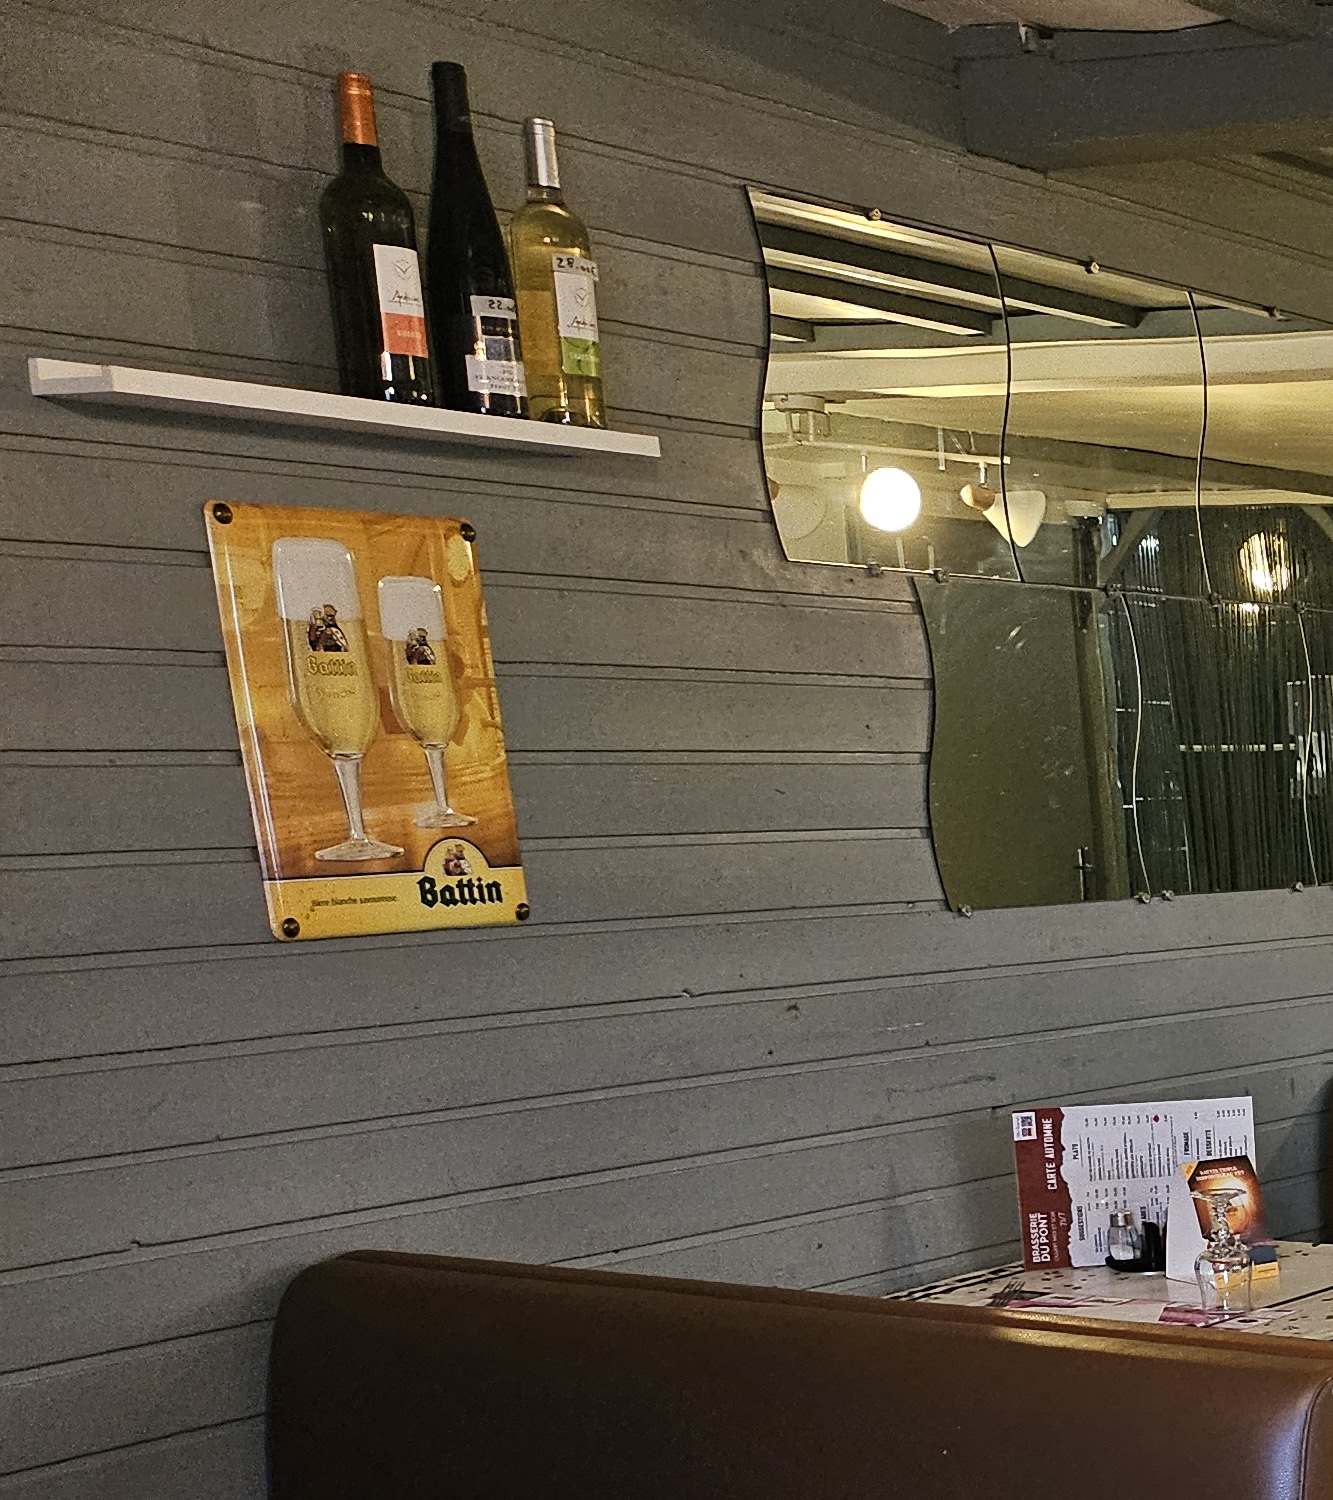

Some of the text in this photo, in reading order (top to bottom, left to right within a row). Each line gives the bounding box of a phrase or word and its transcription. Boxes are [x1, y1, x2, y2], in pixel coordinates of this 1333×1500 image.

[416, 876, 503, 908] Battin
[1041, 1117, 1057, 1189] CARTE AUTOMNE
[1028, 1212, 1041, 1262] BRASSERIE
[1037, 1212, 1051, 1261] DU PONT
